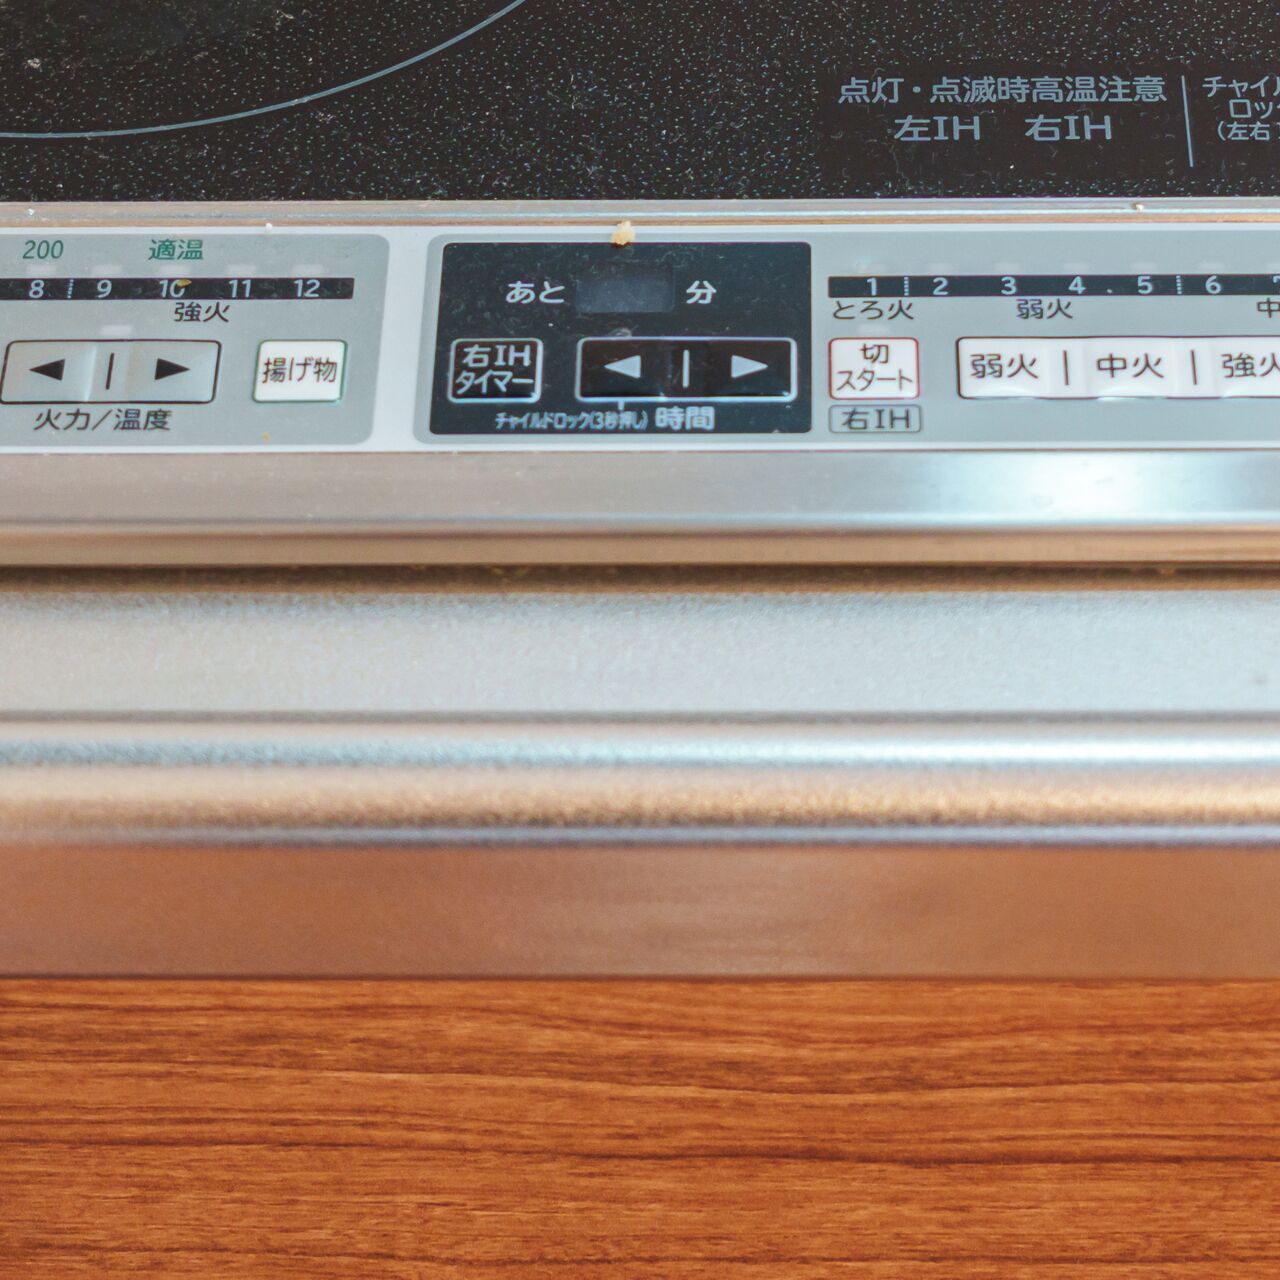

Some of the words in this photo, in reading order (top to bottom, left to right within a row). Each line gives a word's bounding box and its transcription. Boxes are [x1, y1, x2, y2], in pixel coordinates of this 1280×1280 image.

[837, 74, 1168, 104] 点灯・点滅時高温注意
[893, 114, 981, 142] 左IH
[1024, 113, 1113, 142] 右IH
[22, 239, 64, 260] 200
[147, 238, 204, 261] 適温
[27, 280, 45, 298] 8
[95, 280, 112, 298] 9
[159, 279, 186, 298] 10
[228, 279, 253, 298] 11
[293, 279, 321, 298] 12
[505, 280, 565, 305] あと
[685, 280, 717, 305] 分
[866, 277, 878, 296] 1
[932, 277, 949, 296] 2
[1000, 277, 1017, 296] 3
[1068, 277, 1086, 296] 4
[1137, 276, 1154, 295] 5
[1204, 276, 1222, 295] 6
[174, 301, 230, 323] 強火
[832, 299, 915, 321] とろ火
[1016, 298, 1073, 320] 弱火
[462, 343, 532, 368] 右IH
[860, 343, 890, 364] 切
[970, 353, 1039, 379] 弱火
[1095, 353, 1164, 379] 中火
[262, 357, 338, 384] 揚げ物
[455, 370, 535, 395] タイマー
[835, 367, 913, 392] スタート
[33, 407, 172, 431] 火力/温度
[654, 405, 715, 431] 時間
[841, 407, 910, 431] 右IH
